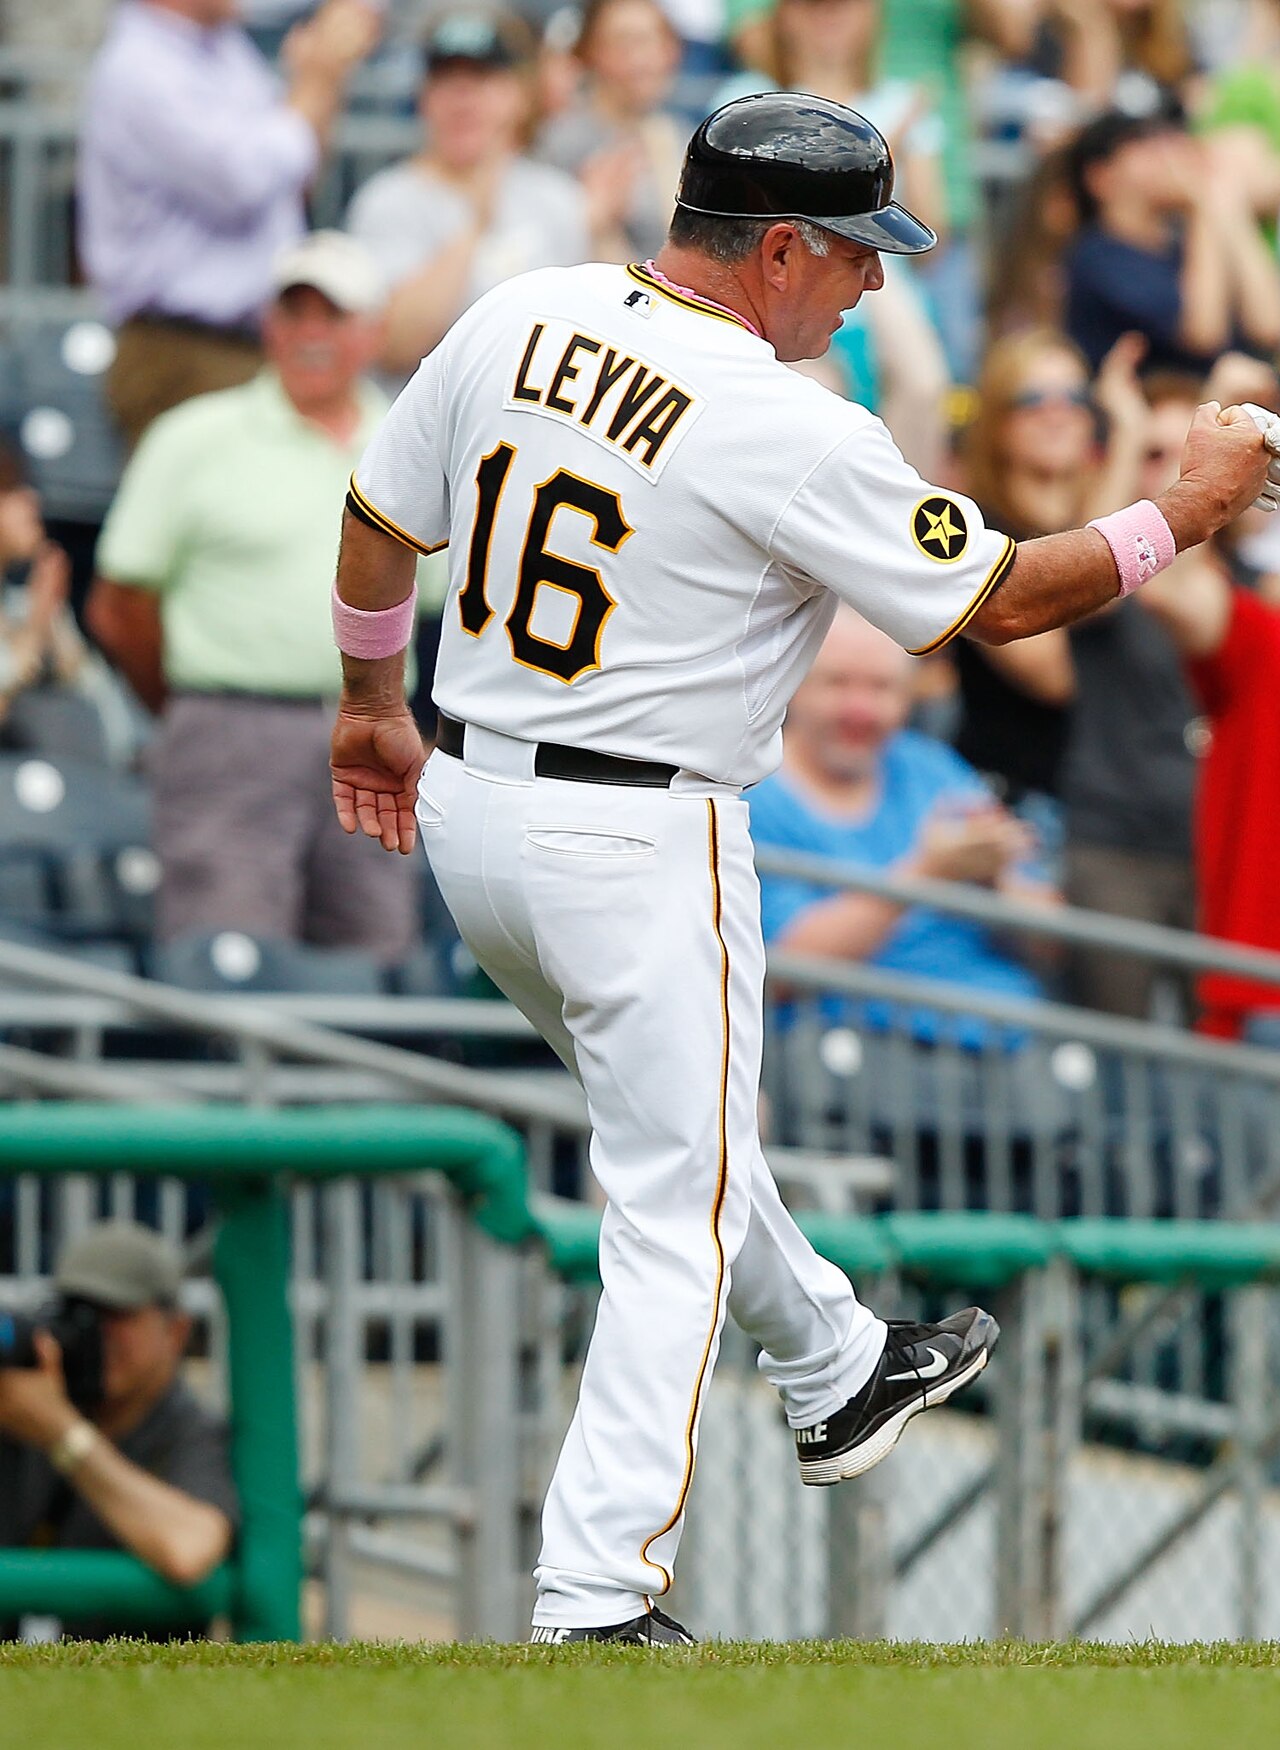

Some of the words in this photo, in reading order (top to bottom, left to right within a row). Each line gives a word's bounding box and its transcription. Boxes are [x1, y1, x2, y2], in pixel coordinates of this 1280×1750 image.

[512, 322, 695, 470] LEYVA
[458, 439, 637, 687] 16
[796, 1421, 828, 1444] IKE
